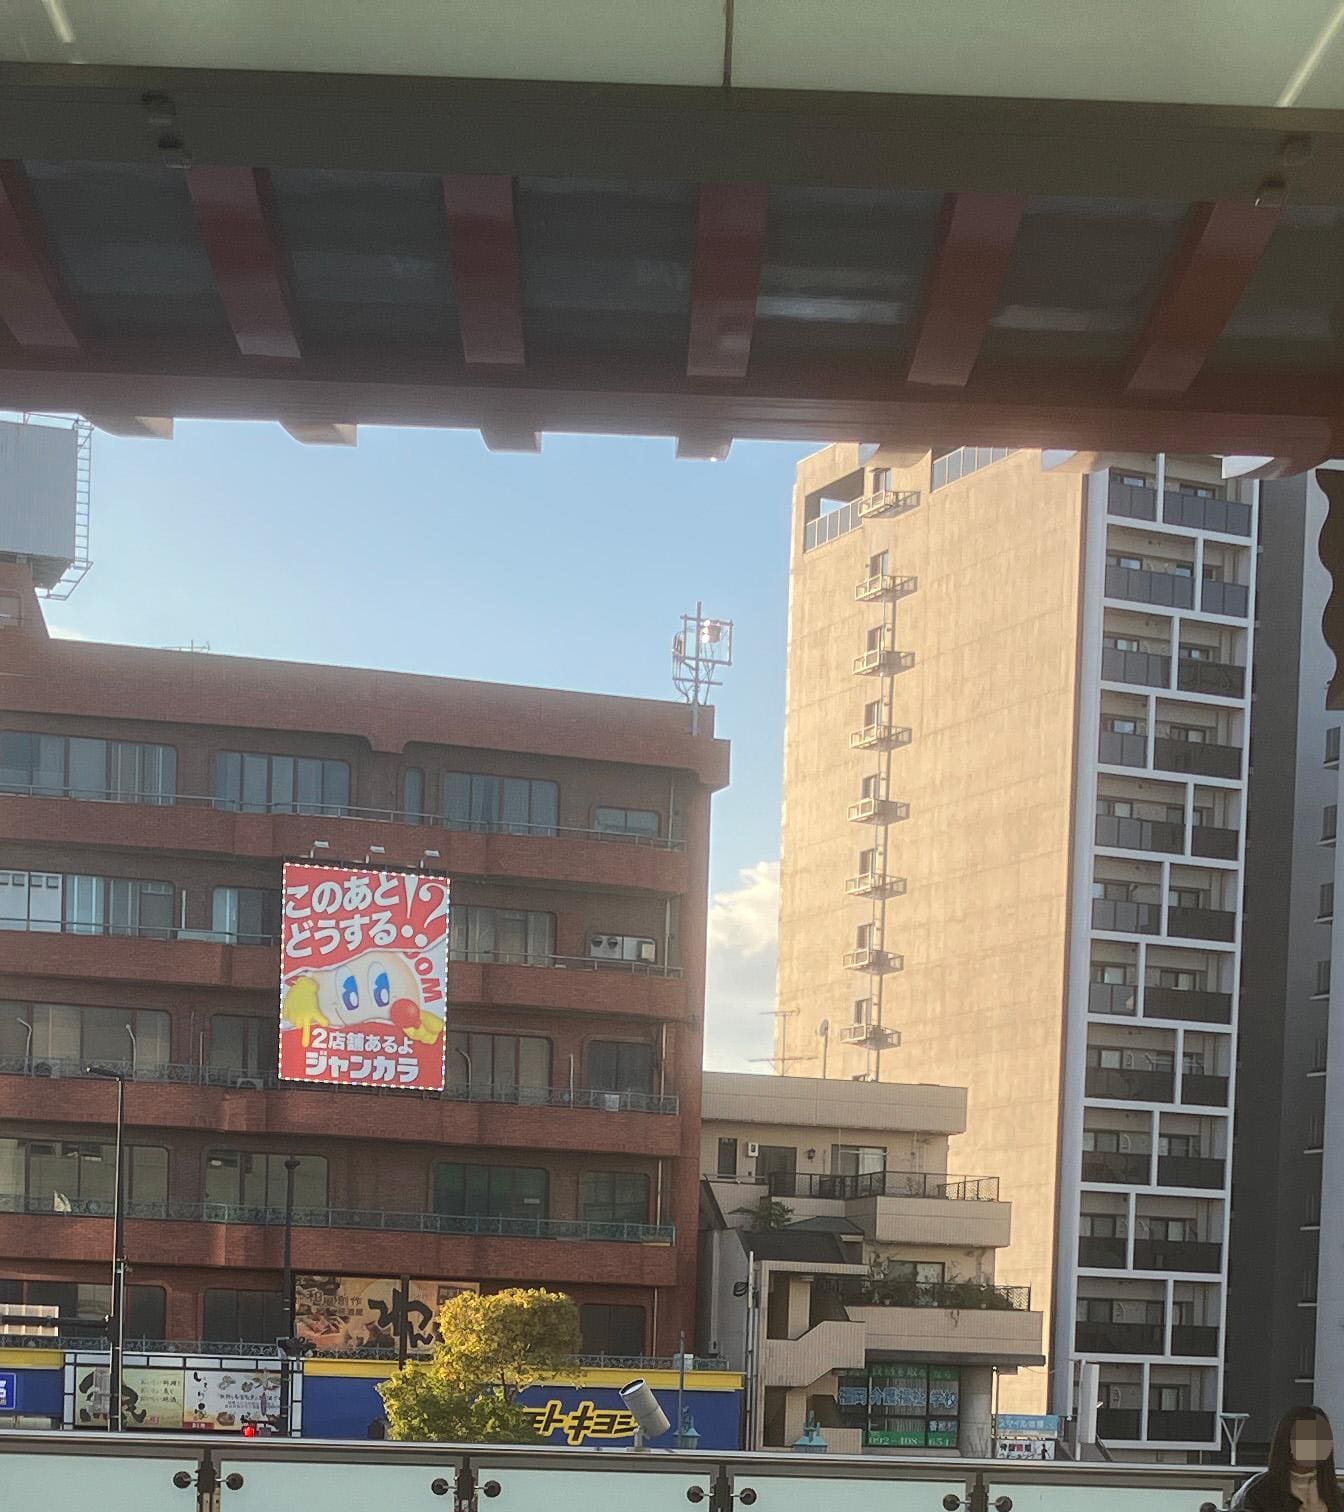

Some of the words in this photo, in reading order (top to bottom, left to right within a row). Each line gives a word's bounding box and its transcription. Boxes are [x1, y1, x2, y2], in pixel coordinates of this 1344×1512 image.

[286, 873, 400, 919] このあと
[311, 1027, 414, 1055] 2店舗あるよ
[306, 1052, 420, 1083] ジャンカラ
